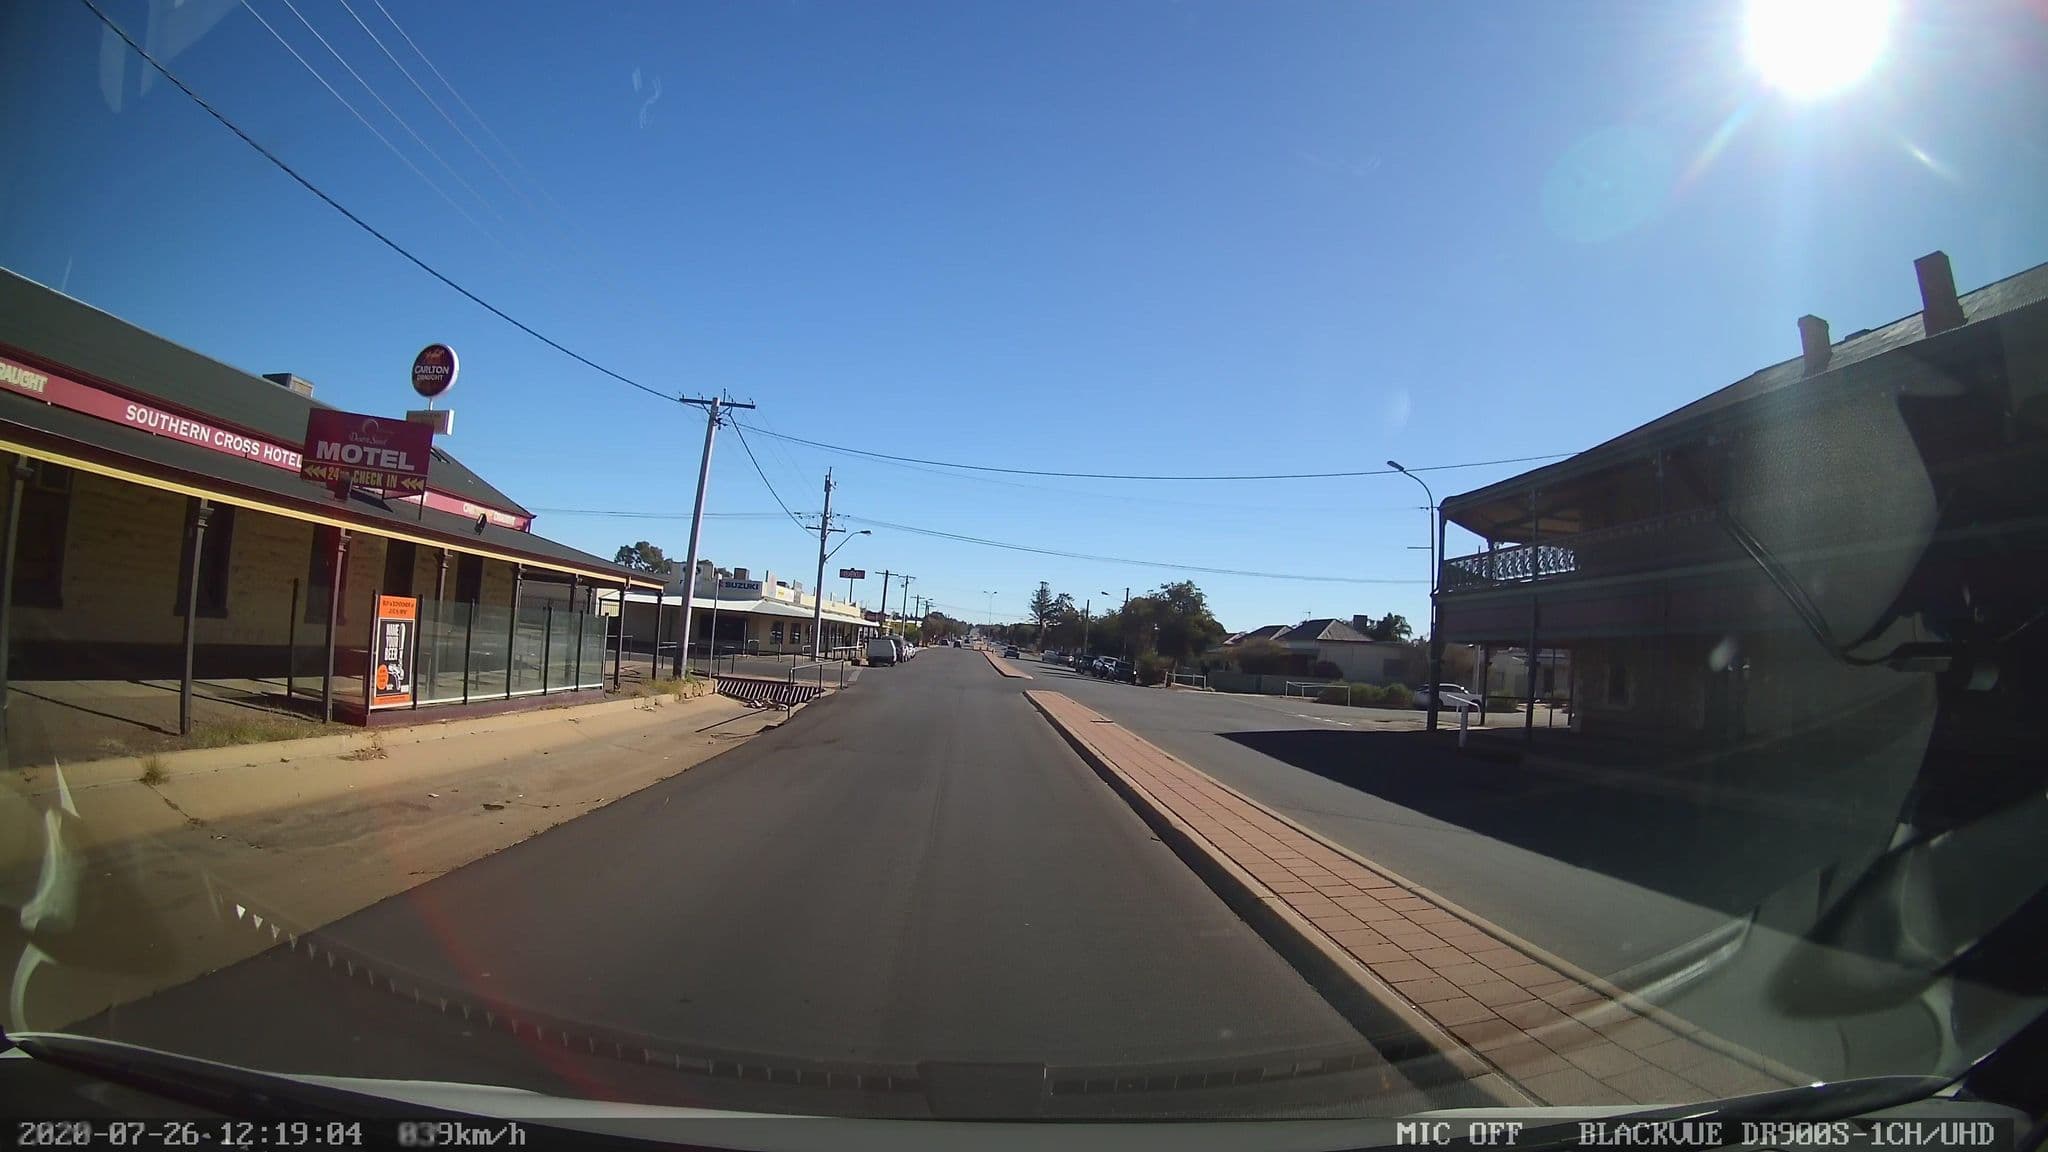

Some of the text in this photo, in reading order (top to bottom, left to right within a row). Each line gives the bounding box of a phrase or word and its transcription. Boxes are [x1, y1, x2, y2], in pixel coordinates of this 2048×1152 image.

[414, 365, 450, 375] CARLTON
[125, 404, 303, 469] SOUTHERN CROSS HOTEL
[316, 440, 415, 471] MOTEL
[327, 467, 398, 489] 24 CHECK IN
[725, 582, 759, 590] SUZUKI
